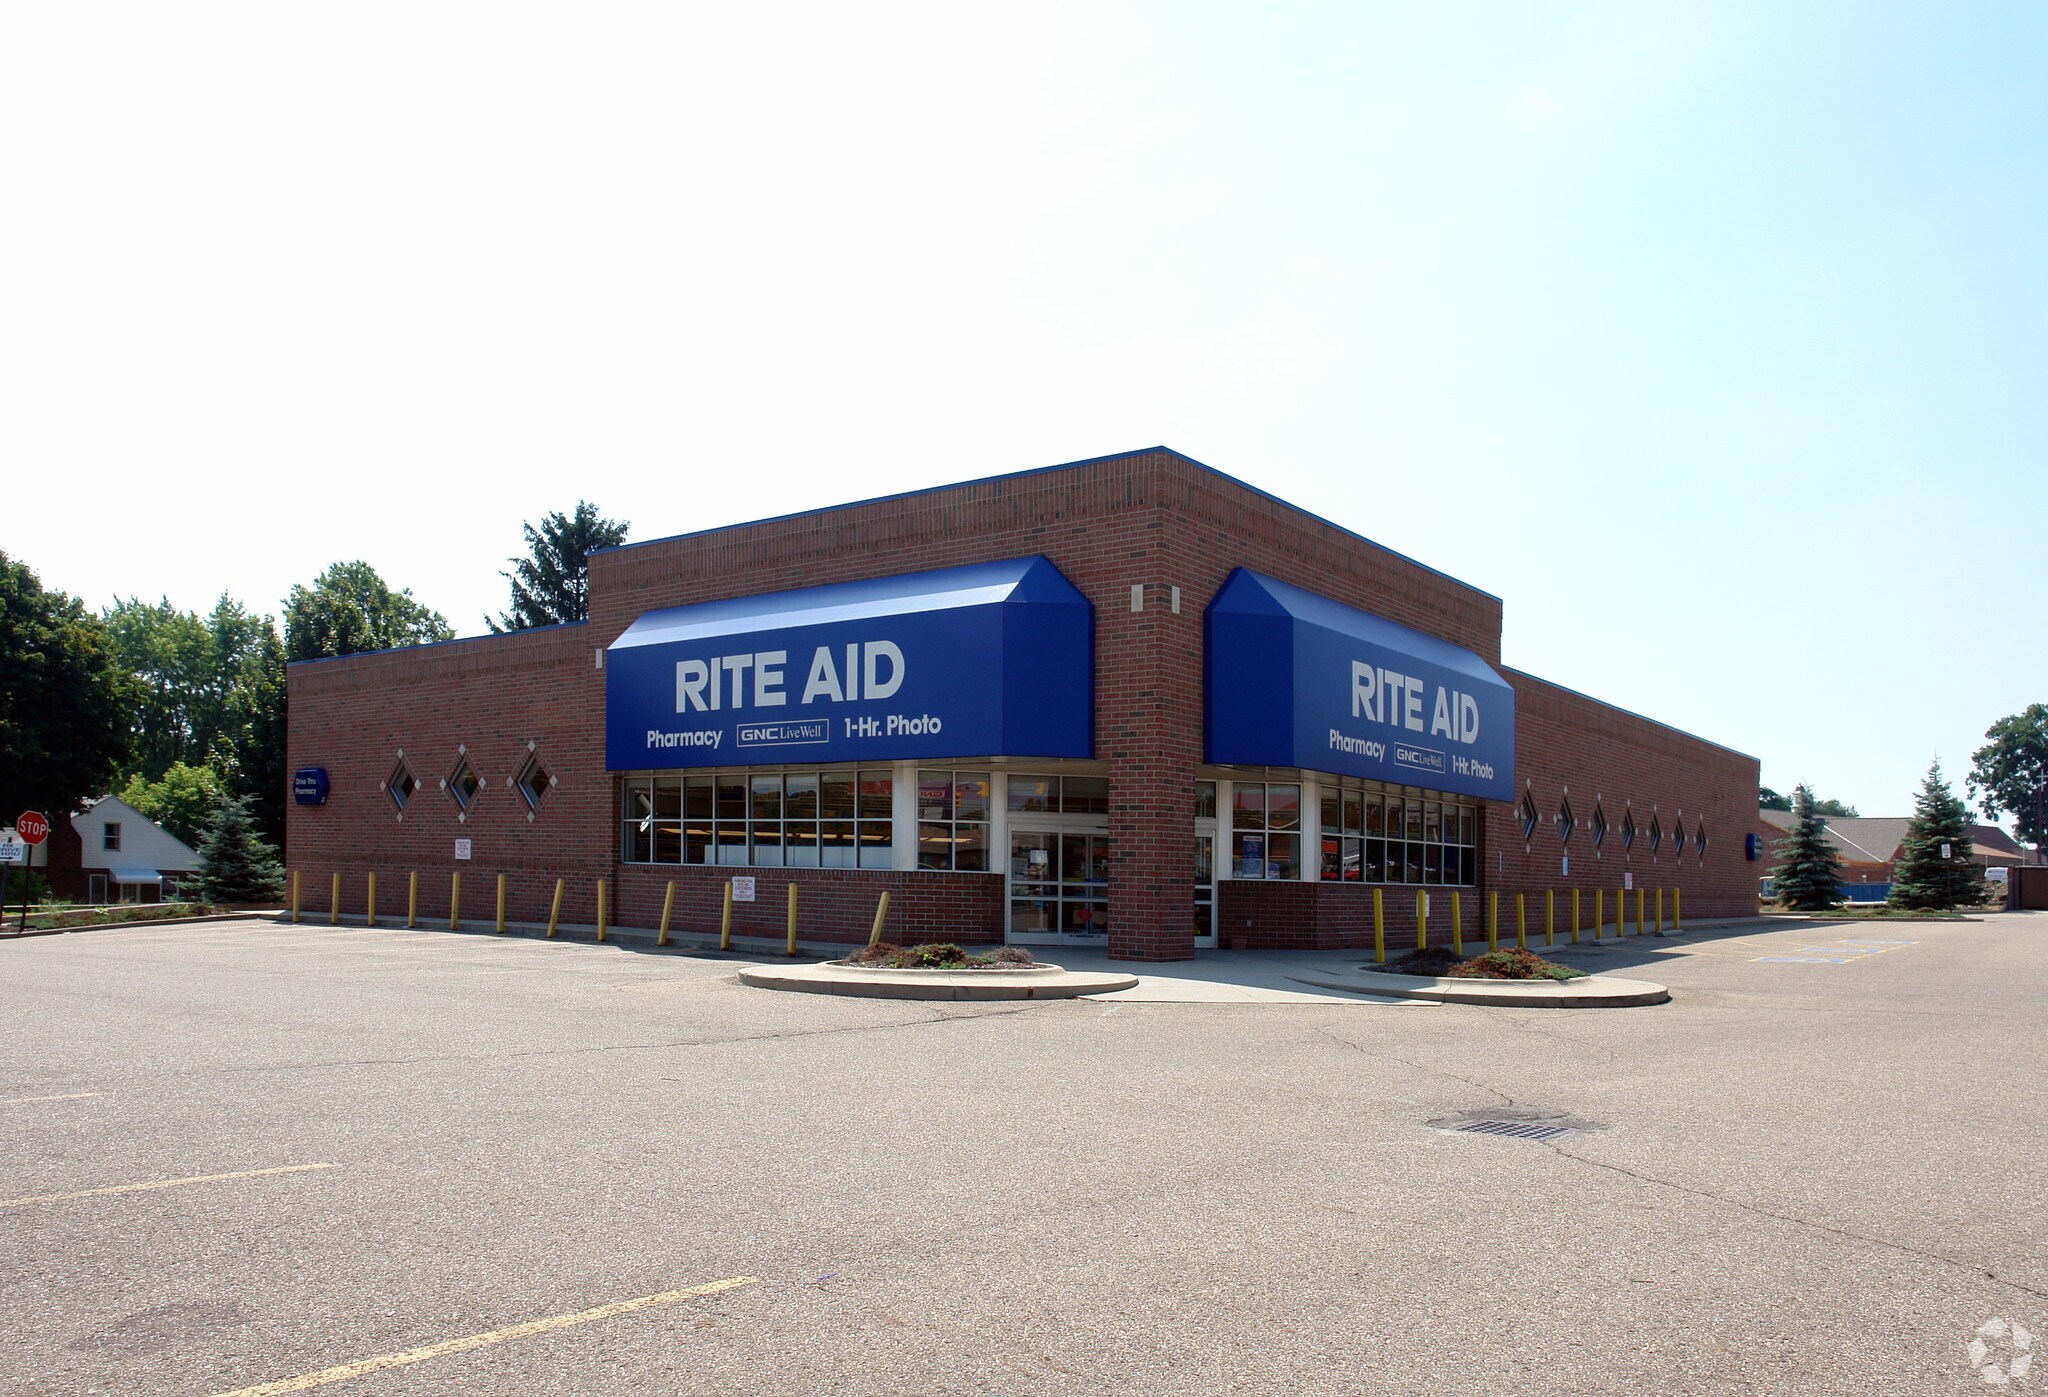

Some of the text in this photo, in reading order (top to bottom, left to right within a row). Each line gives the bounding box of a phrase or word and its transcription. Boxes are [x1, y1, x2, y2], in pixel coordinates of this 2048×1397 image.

[676, 640, 905, 713] RITE AID
[1352, 660, 1479, 744] RITE AID
[741, 728, 779, 741] GNC
[845, 714, 942, 738] 1-Hr. Photo
[647, 730, 723, 749] Pharmacy
[1329, 728, 1386, 763] Pharmacy
[1396, 748, 1419, 763] GNC
[1452, 755, 1494, 780] 1-Hr. Photo
[295, 788, 317, 796] Pharmacy
[20, 820, 47, 836] STOP
